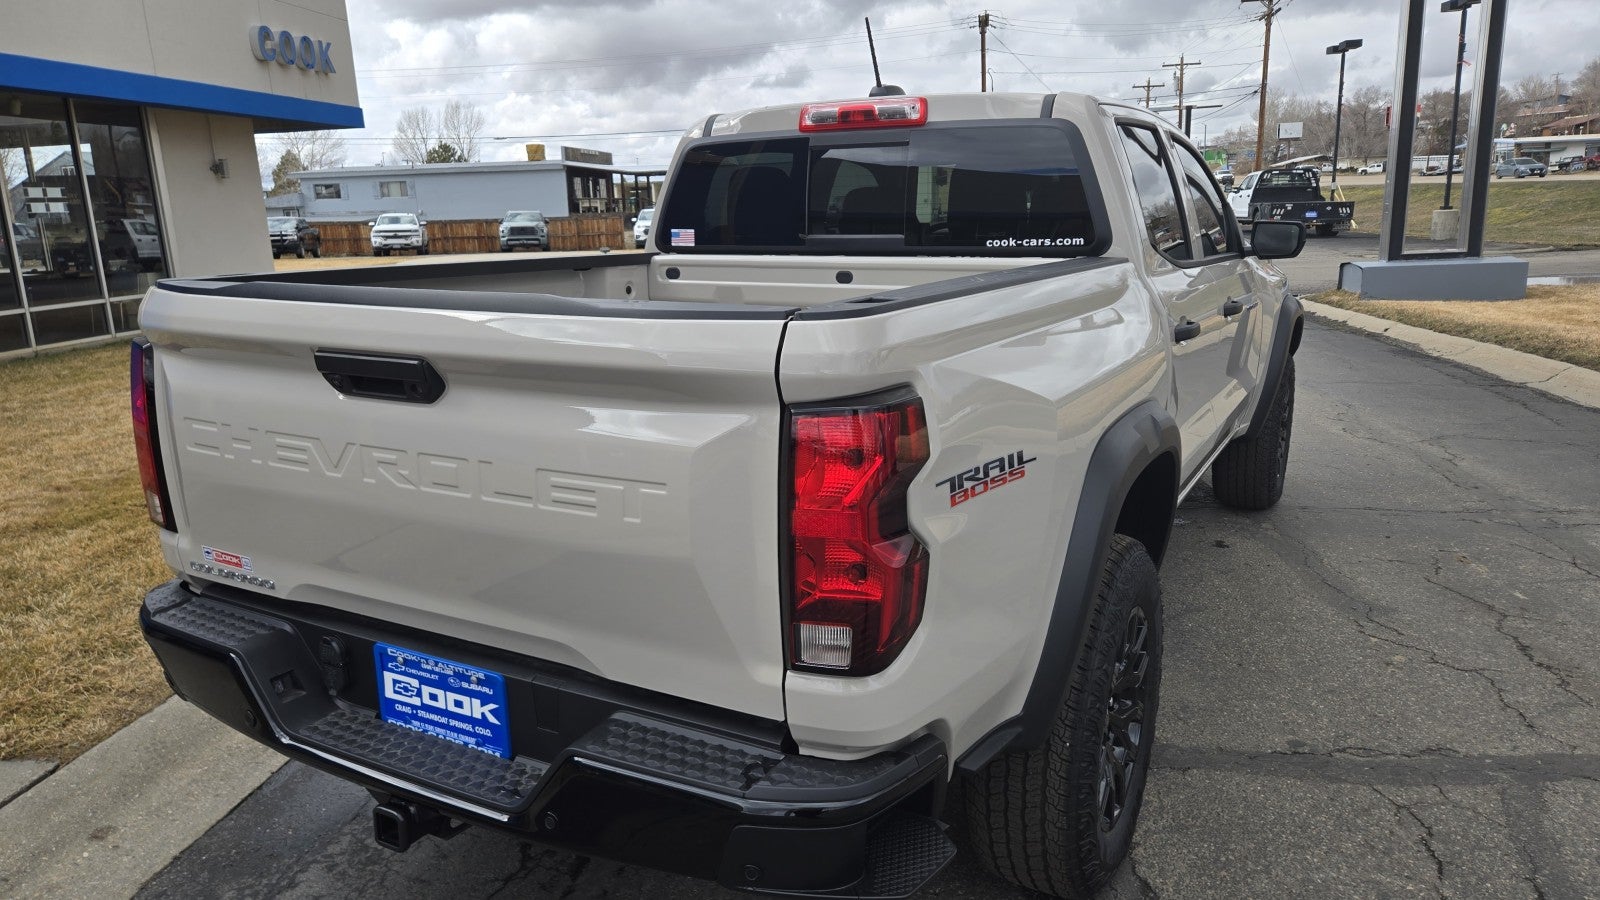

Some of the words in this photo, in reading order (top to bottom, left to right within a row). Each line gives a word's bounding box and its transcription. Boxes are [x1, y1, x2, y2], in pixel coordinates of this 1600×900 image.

[250, 25, 336, 74] COOK
[986, 237, 1085, 247] cook-cars.com
[184, 416, 668, 524] CHEVROLET
[935, 450, 1037, 494] TRAIL
[950, 465, 1026, 508] BOSS
[405, 667, 439, 680] CHEVROLET
[462, 681, 493, 695] SUBARU
[395, 704, 412, 714] CRAIG
[417, 710, 448, 724] STEAMBOAT
[476, 726, 493, 737] COLO.
